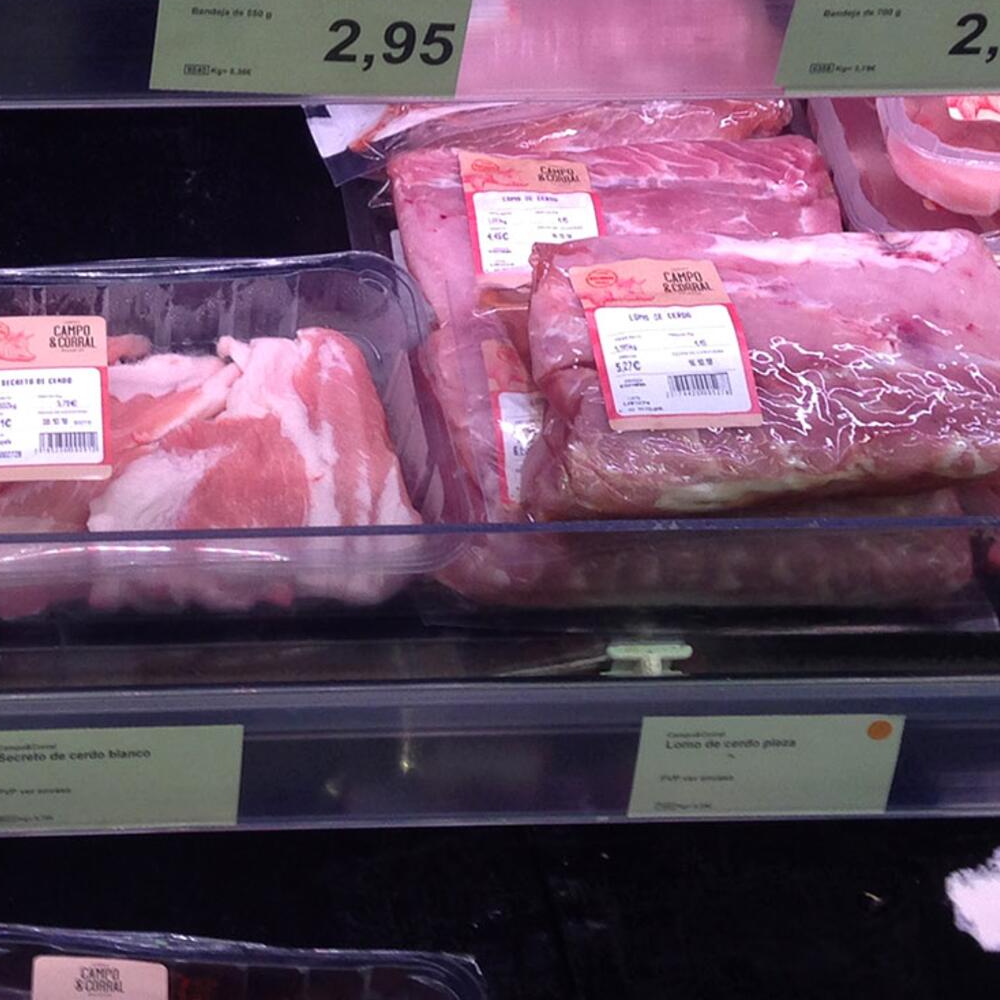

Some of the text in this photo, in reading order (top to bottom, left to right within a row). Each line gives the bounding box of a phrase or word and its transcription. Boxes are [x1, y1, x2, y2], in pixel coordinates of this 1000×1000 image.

[192, 7, 230, 18] Bandeja
[232, 8, 244, 18] de
[265, 11, 272, 21] g
[824, 9, 860, 19] Bandeja
[863, 8, 874, 17] de
[895, 10, 901, 18] g
[323, 18, 456, 72] 2,95
[663, 271, 703, 283] CAMPO
[53, 325, 91, 337] CAMPO
[666, 740, 701, 749] Lomo
[705, 740, 720, 749] de
[724, 739, 759, 748] cerdo
[50, 751, 65, 761] de
[70, 750, 104, 760] cerdo
[108, 748, 152, 759] blanco
[80, 967, 120, 979] CAMPO
